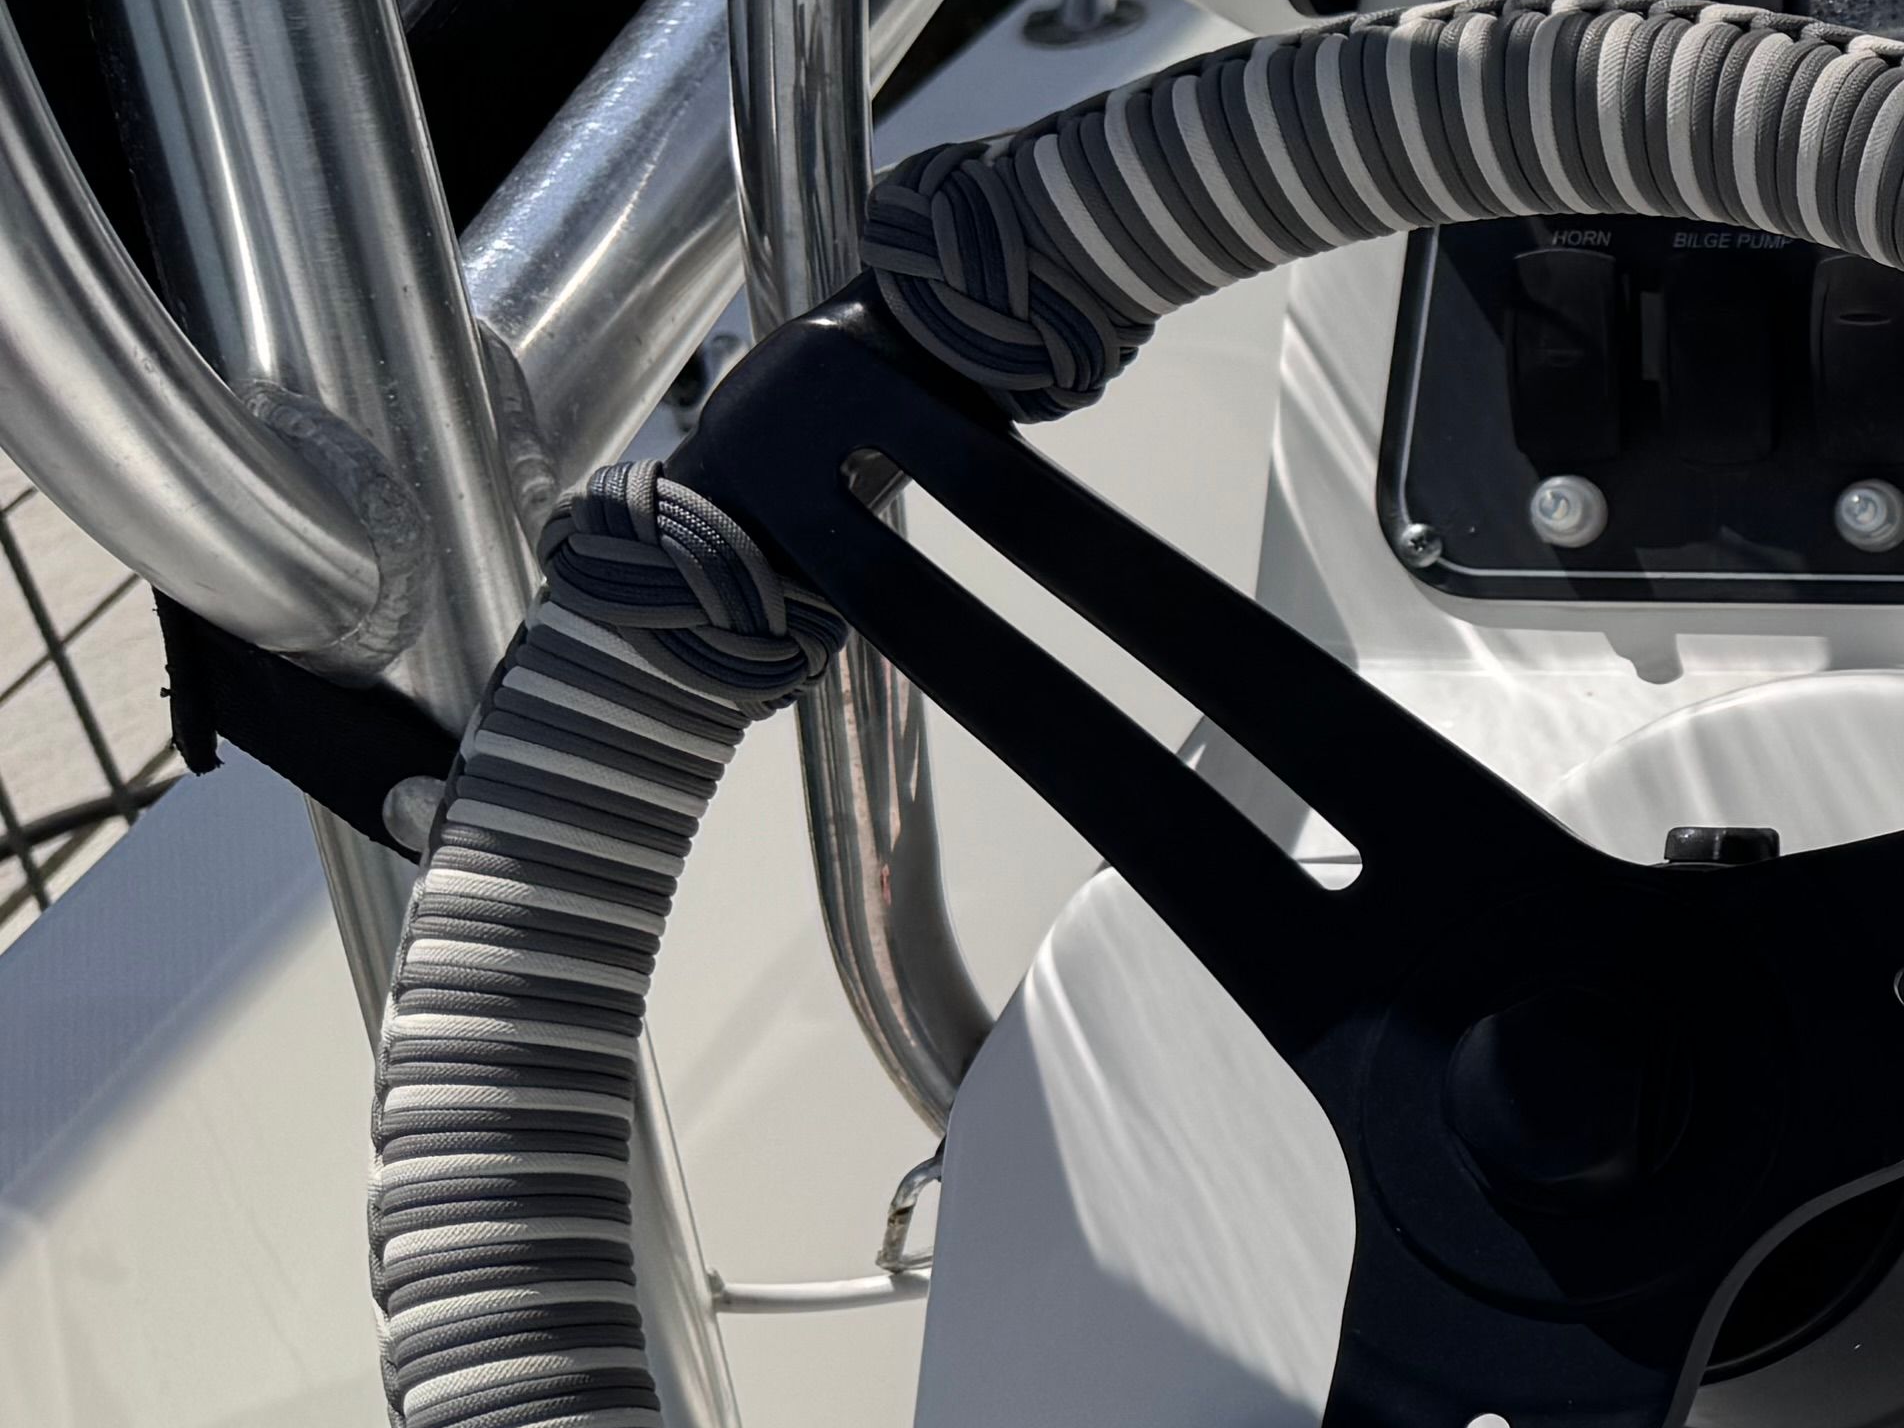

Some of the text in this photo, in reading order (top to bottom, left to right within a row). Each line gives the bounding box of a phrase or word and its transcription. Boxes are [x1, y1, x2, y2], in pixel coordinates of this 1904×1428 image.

[1552, 229, 1613, 247] HORN
[1672, 231, 1794, 250] BILGE PUMP
